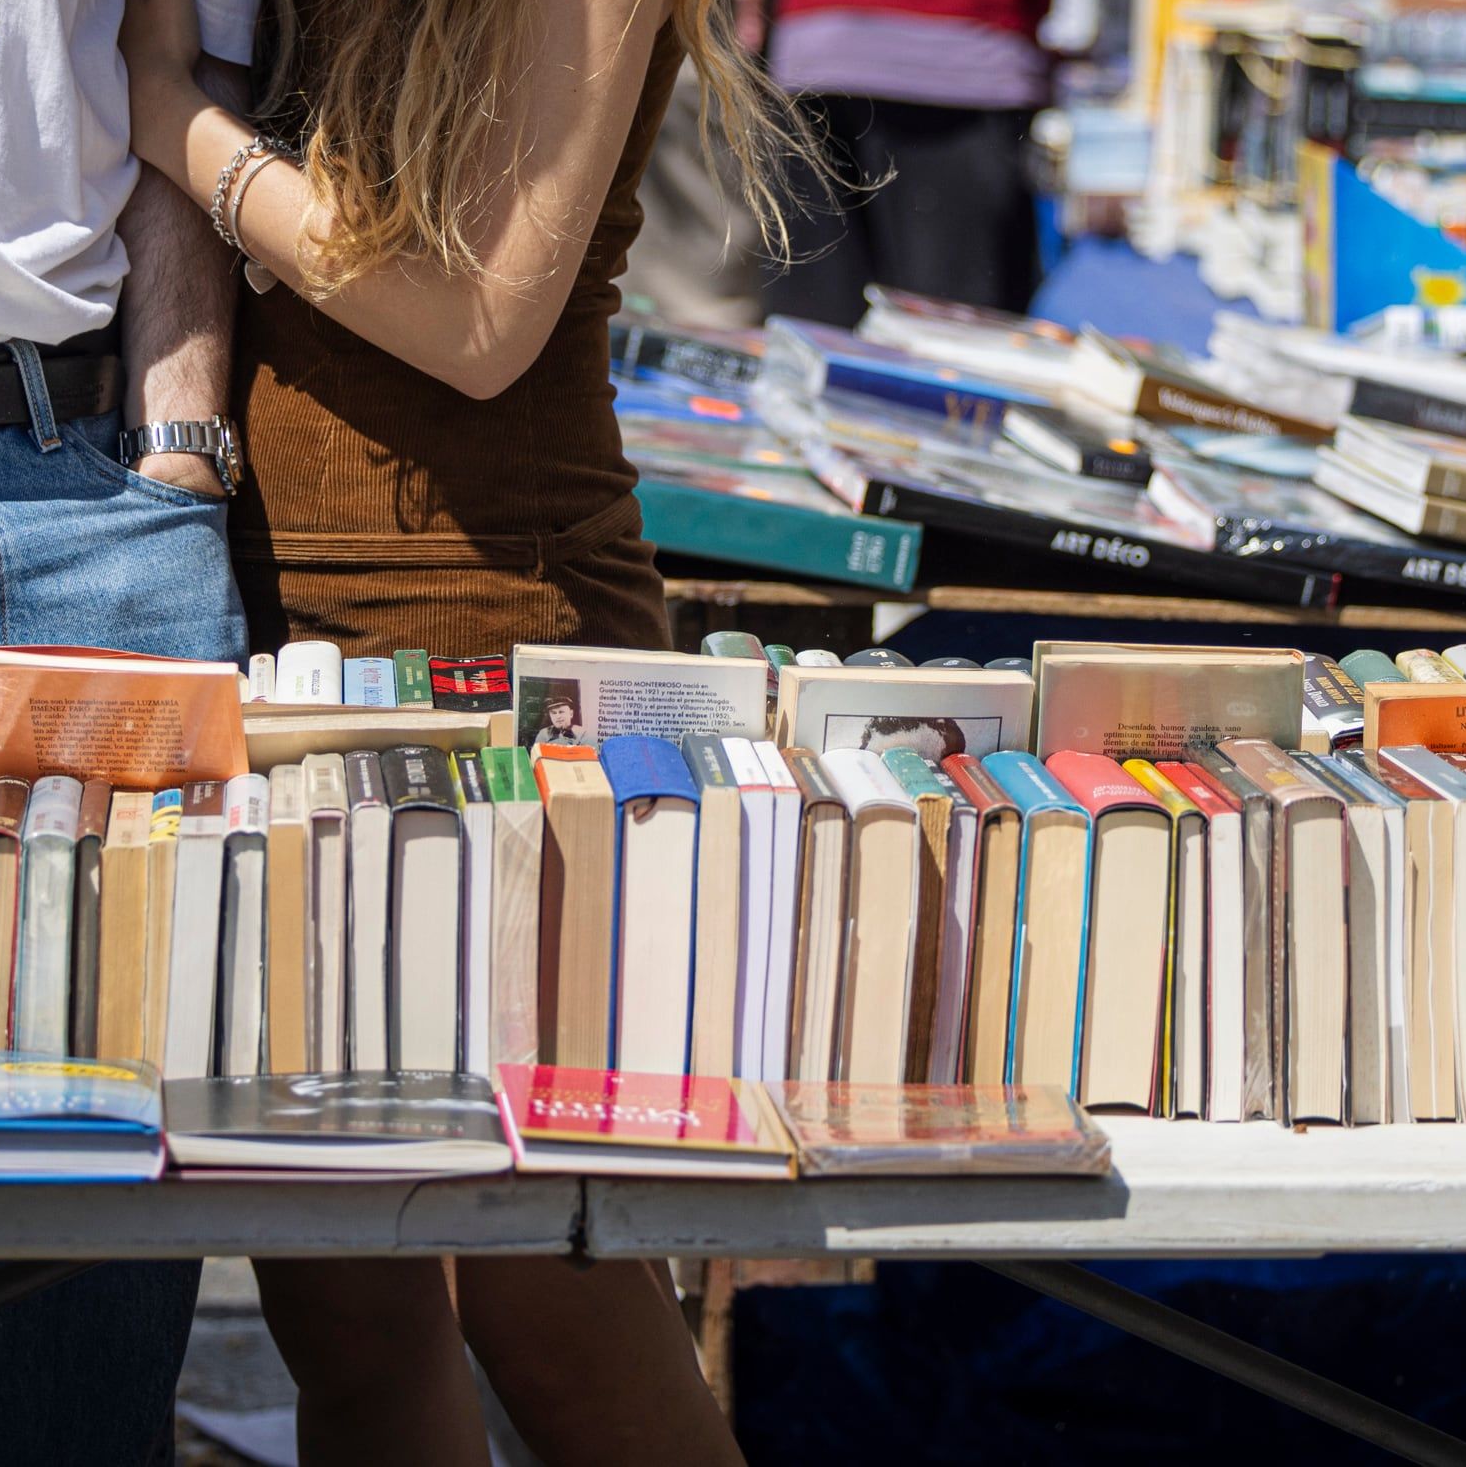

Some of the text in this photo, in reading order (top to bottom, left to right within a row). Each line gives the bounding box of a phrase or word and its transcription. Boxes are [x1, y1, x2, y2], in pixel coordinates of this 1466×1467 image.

[1051, 530, 1150, 568] ART DÉCO
[1402, 557, 1443, 582] ART
[1103, 732, 1141, 740] optimismo
